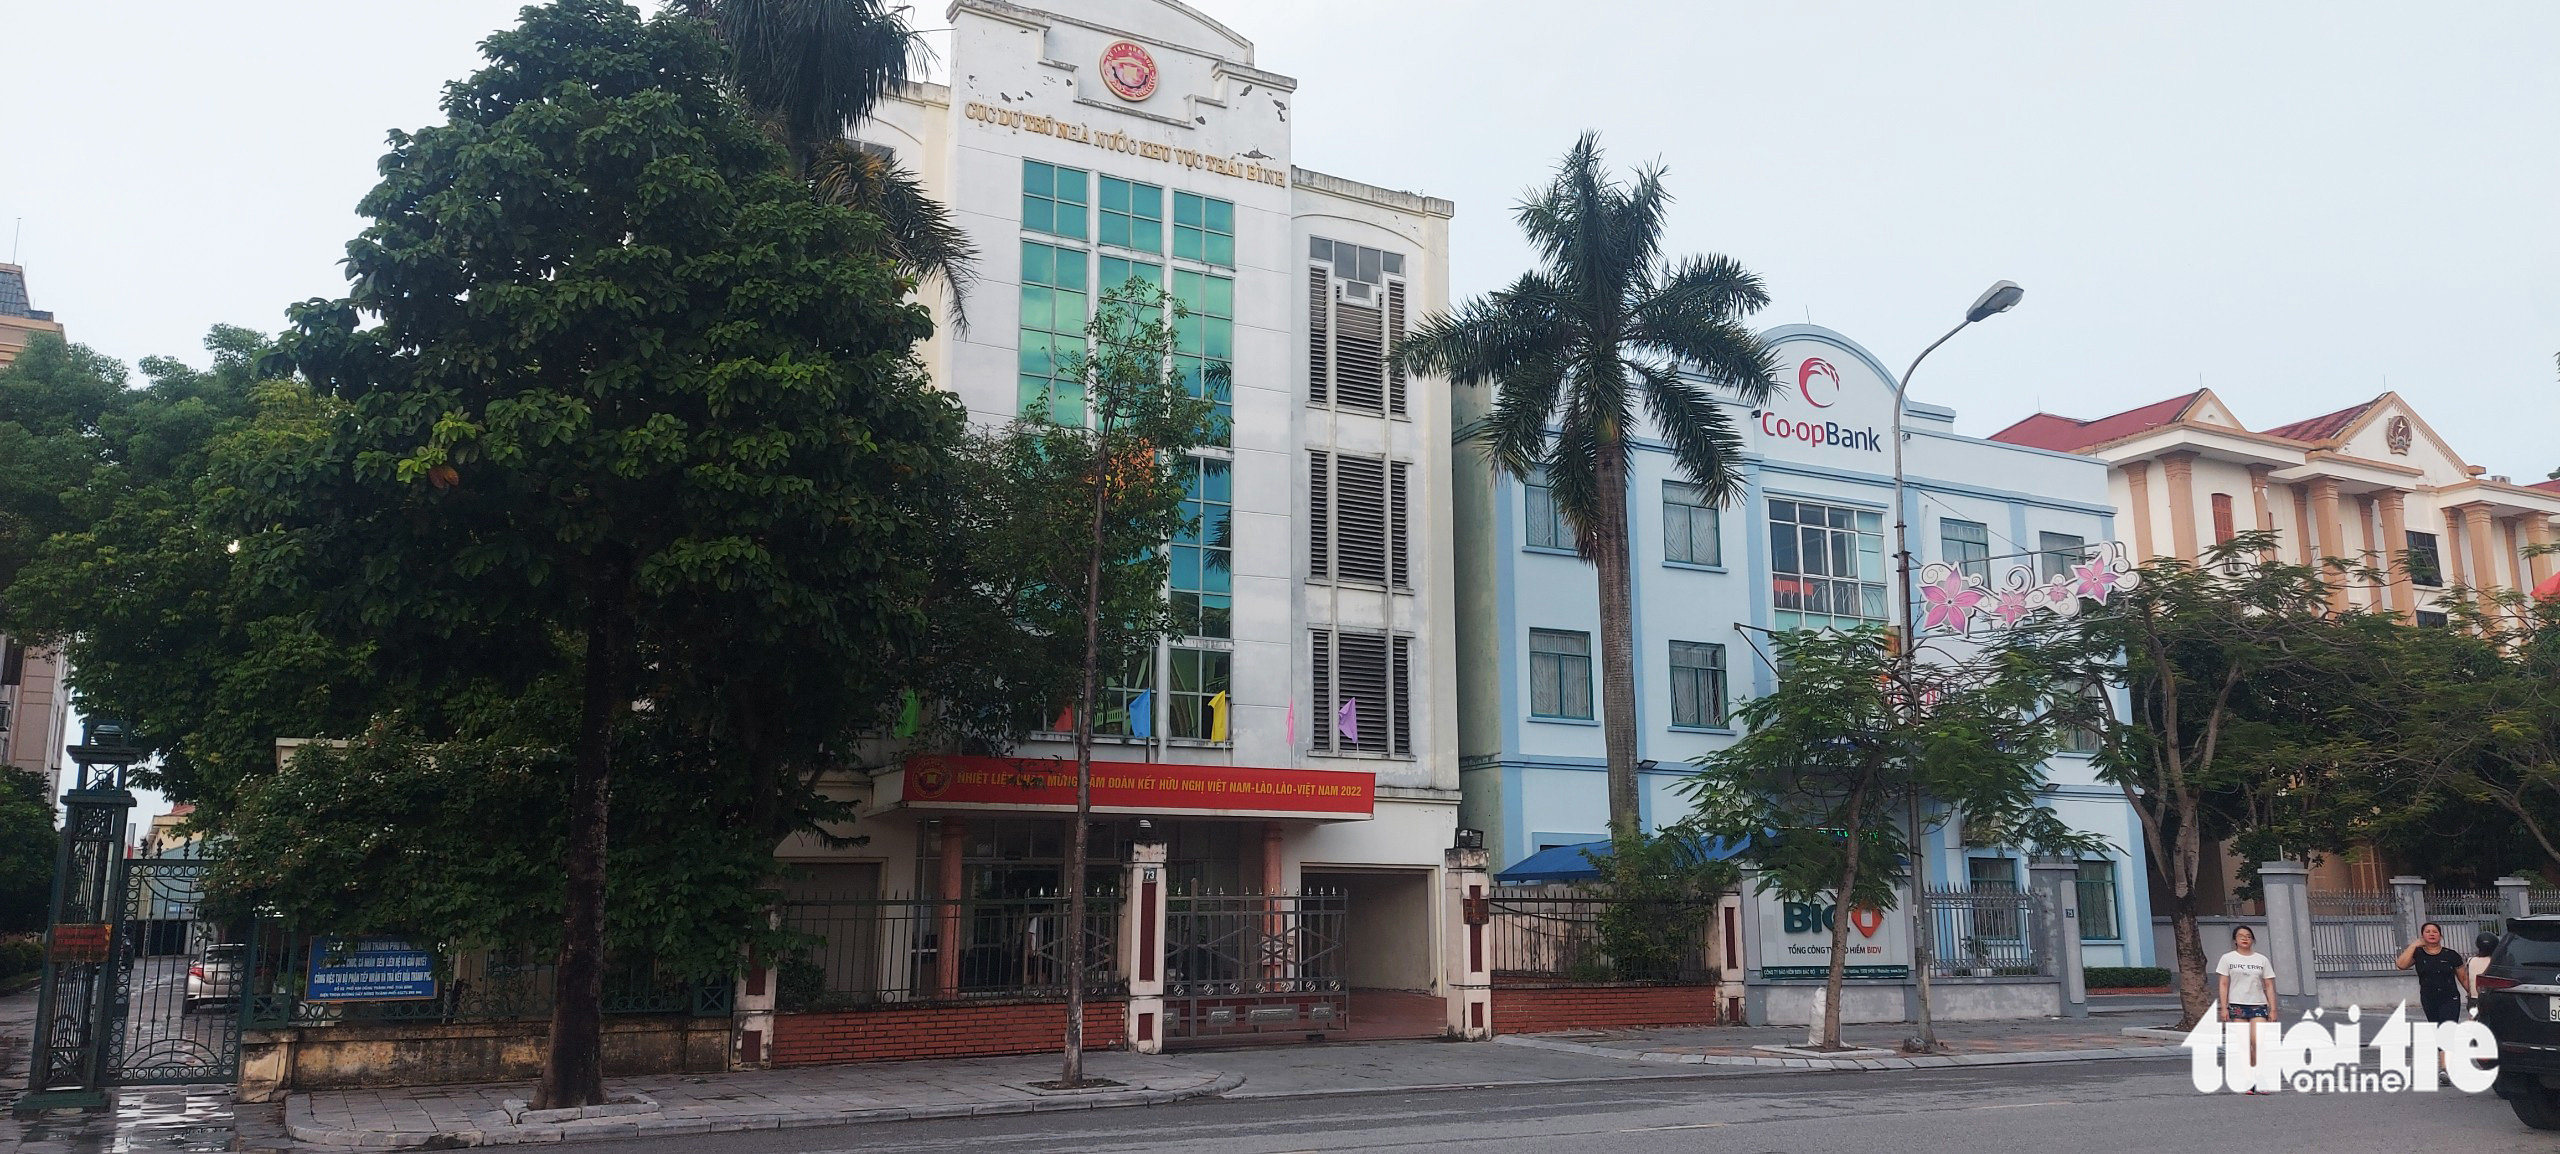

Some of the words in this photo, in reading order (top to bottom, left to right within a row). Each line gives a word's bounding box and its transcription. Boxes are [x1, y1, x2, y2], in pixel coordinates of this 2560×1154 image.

[965, 102, 996, 127] CỤC
[998, 107, 1022, 134] DỰ
[1023, 114, 1056, 135] TRỮ
[1056, 121, 1090, 144] NHÀ
[1094, 128, 1136, 155] NƯỚC
[1139, 141, 1171, 162] KHU
[1174, 148, 1203, 171] VỰC
[1206, 155, 1243, 178] THÁI
[1247, 161, 1286, 188] BÌNH
[957, 770, 988, 787] NHIỆT
[1047, 772, 1078, 787] MỪNG
[1108, 775, 1135, 789] ĐOÀN
[1138, 775, 1156, 790] KẾT
[1159, 777, 1178, 791] HỮU
[1181, 780, 1205, 794] NGHỊ
[1207, 779, 1227, 795] VIỆT
[1318, 785, 1338, 796] NAM
[1341, 786, 1362, 797] 2022
[1145, 871, 1155, 879] 73
[1788, 944, 1806, 954] TỔNG
[1807, 945, 1825, 954] CÔNG
[1850, 944, 1866, 954] HIỂM
[1867, 946, 1882, 954] BIDV
